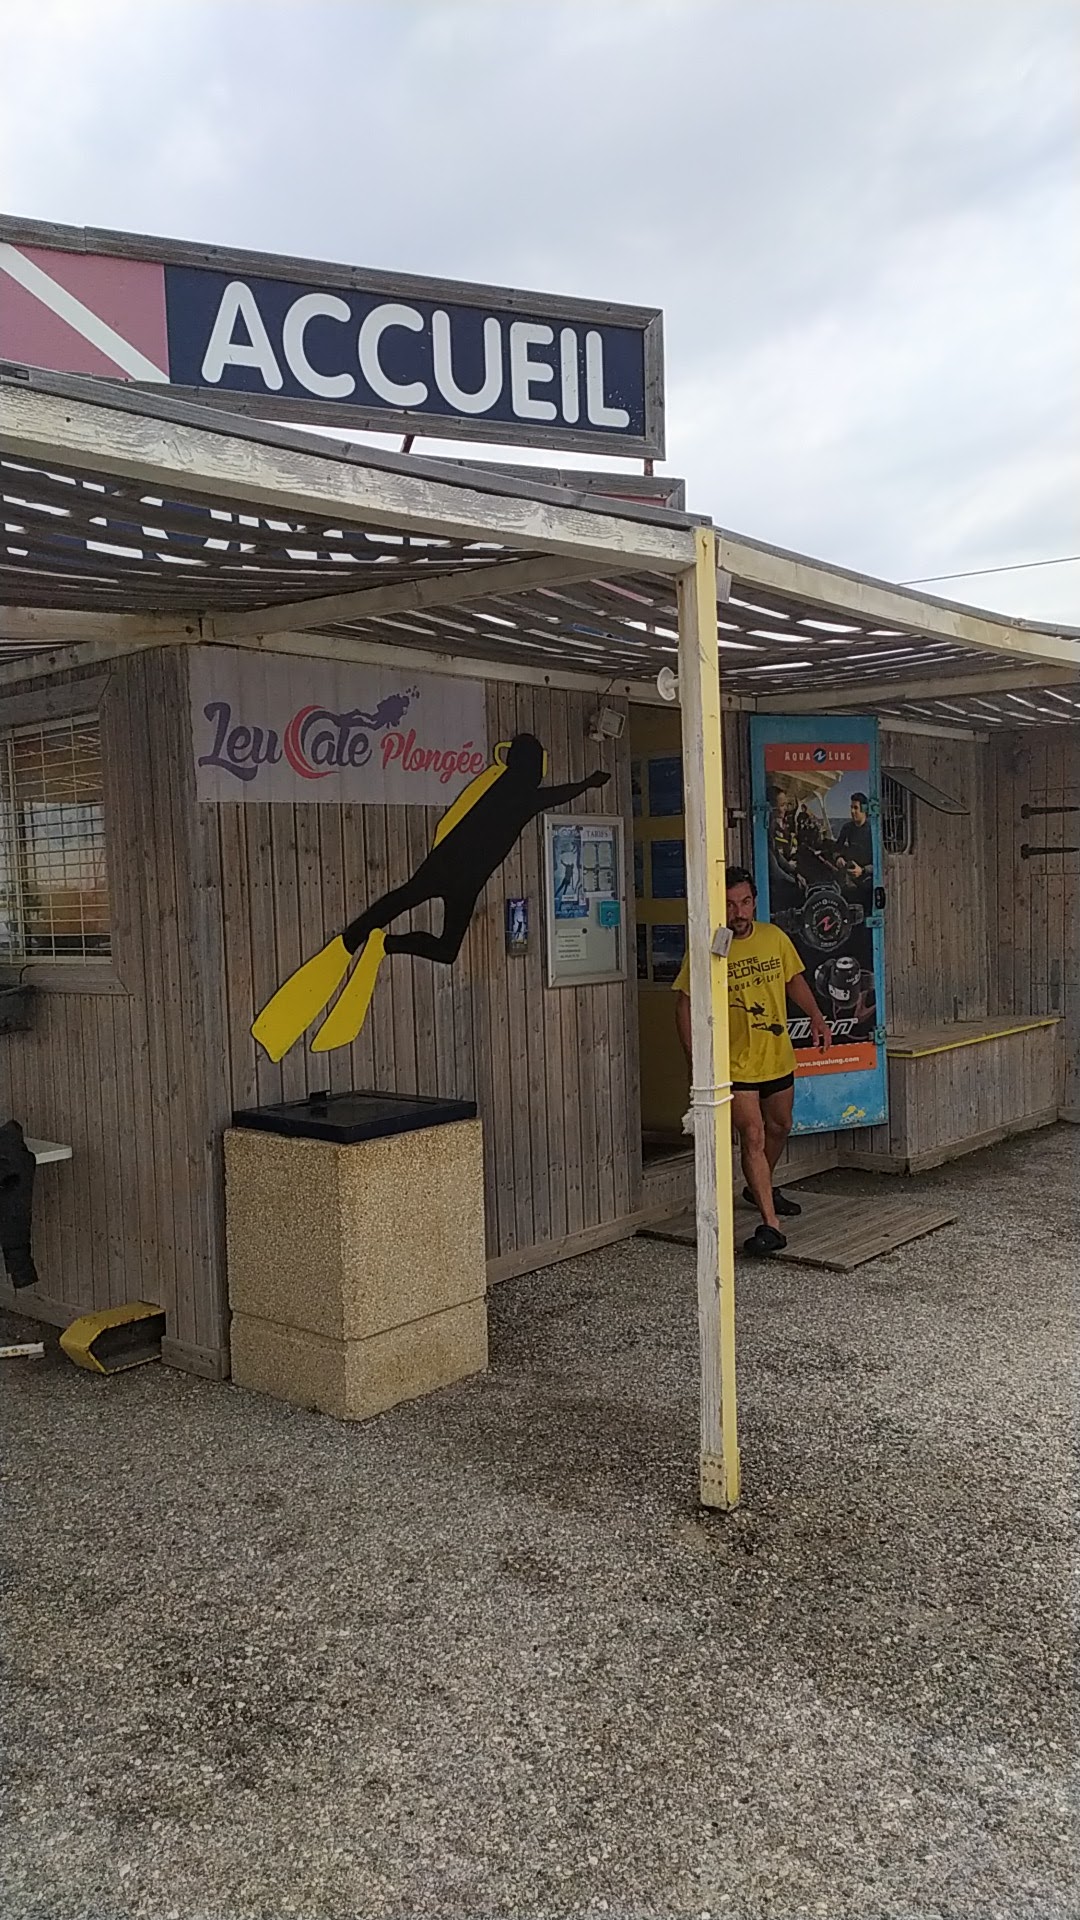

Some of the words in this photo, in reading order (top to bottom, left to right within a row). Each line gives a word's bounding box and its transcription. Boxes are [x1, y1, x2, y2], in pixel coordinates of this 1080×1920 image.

[201, 281, 630, 428] ACCUEIL
[380, 728, 485, 784] Plongée
[784, 751, 811, 762] AQUA
[828, 751, 851, 761] LUNG
[727, 956, 760, 970] ENTRE
[727, 956, 782, 980] PLONGÉE
